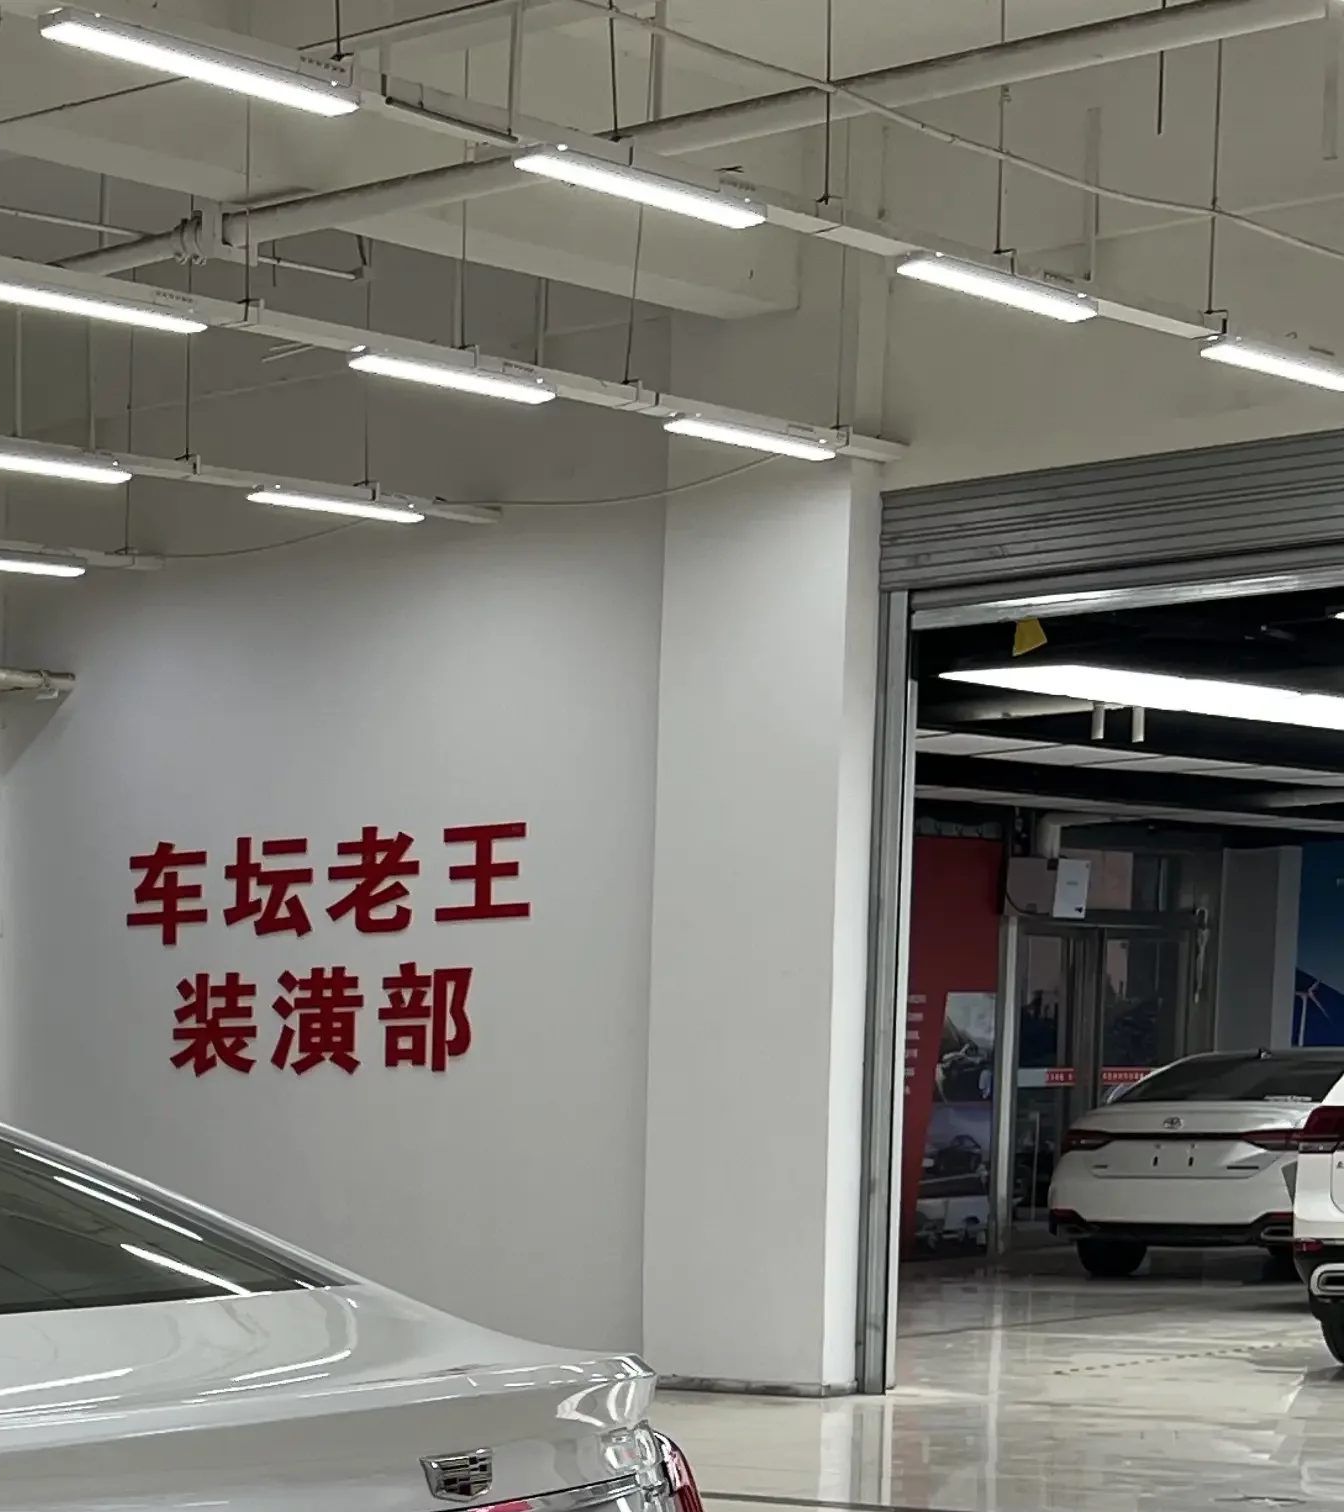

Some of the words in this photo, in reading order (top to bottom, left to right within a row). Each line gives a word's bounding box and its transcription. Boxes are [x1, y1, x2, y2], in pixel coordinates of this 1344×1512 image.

[126, 821, 531, 946] 车坛老王
[169, 961, 474, 1078] 装潢部
